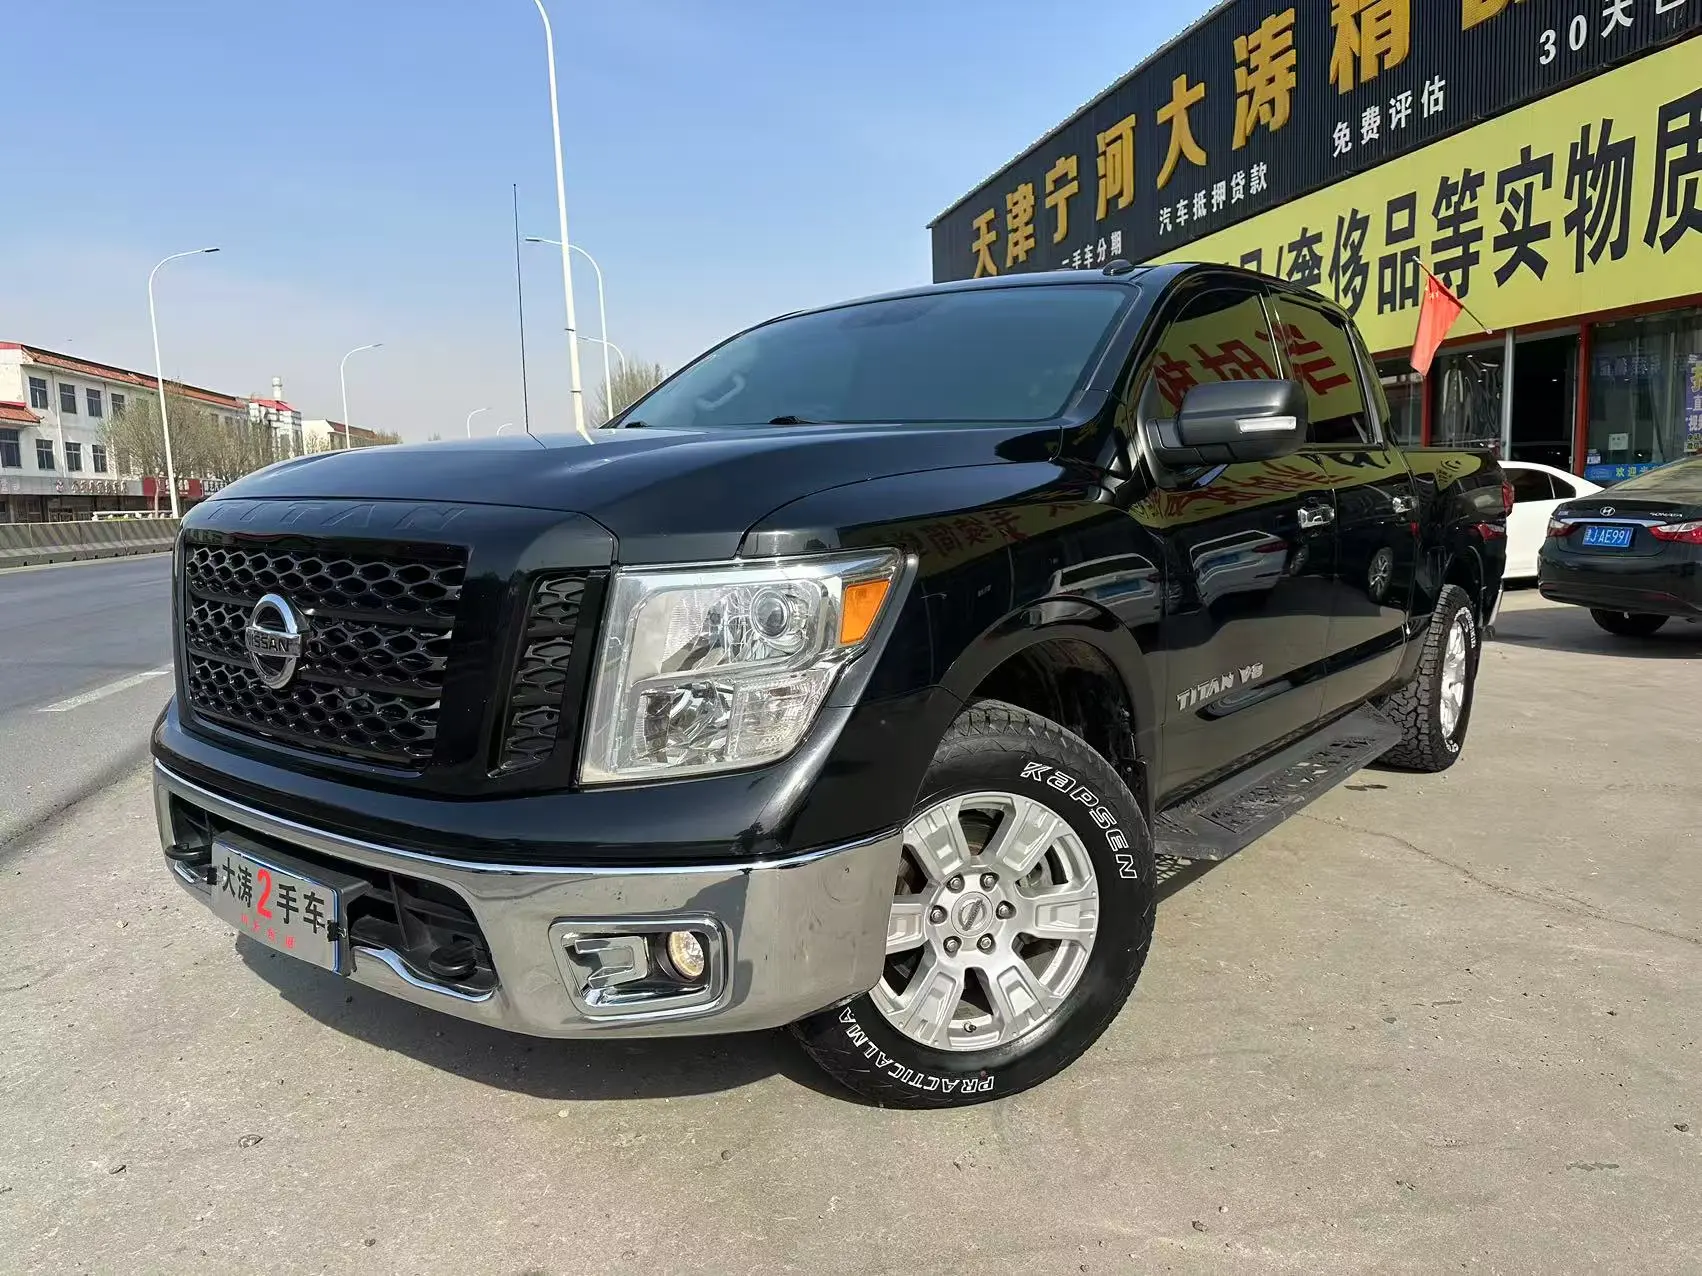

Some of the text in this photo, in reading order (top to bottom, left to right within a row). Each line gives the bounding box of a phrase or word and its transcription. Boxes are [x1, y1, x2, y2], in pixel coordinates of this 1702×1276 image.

[1332, 75, 1446, 158] 免费评估
[1158, 161, 1268, 235] 汽车抵押贷款
[1176, 662, 1264, 711] TITAN V8
[222, 856, 326, 934] 大涛2手车
